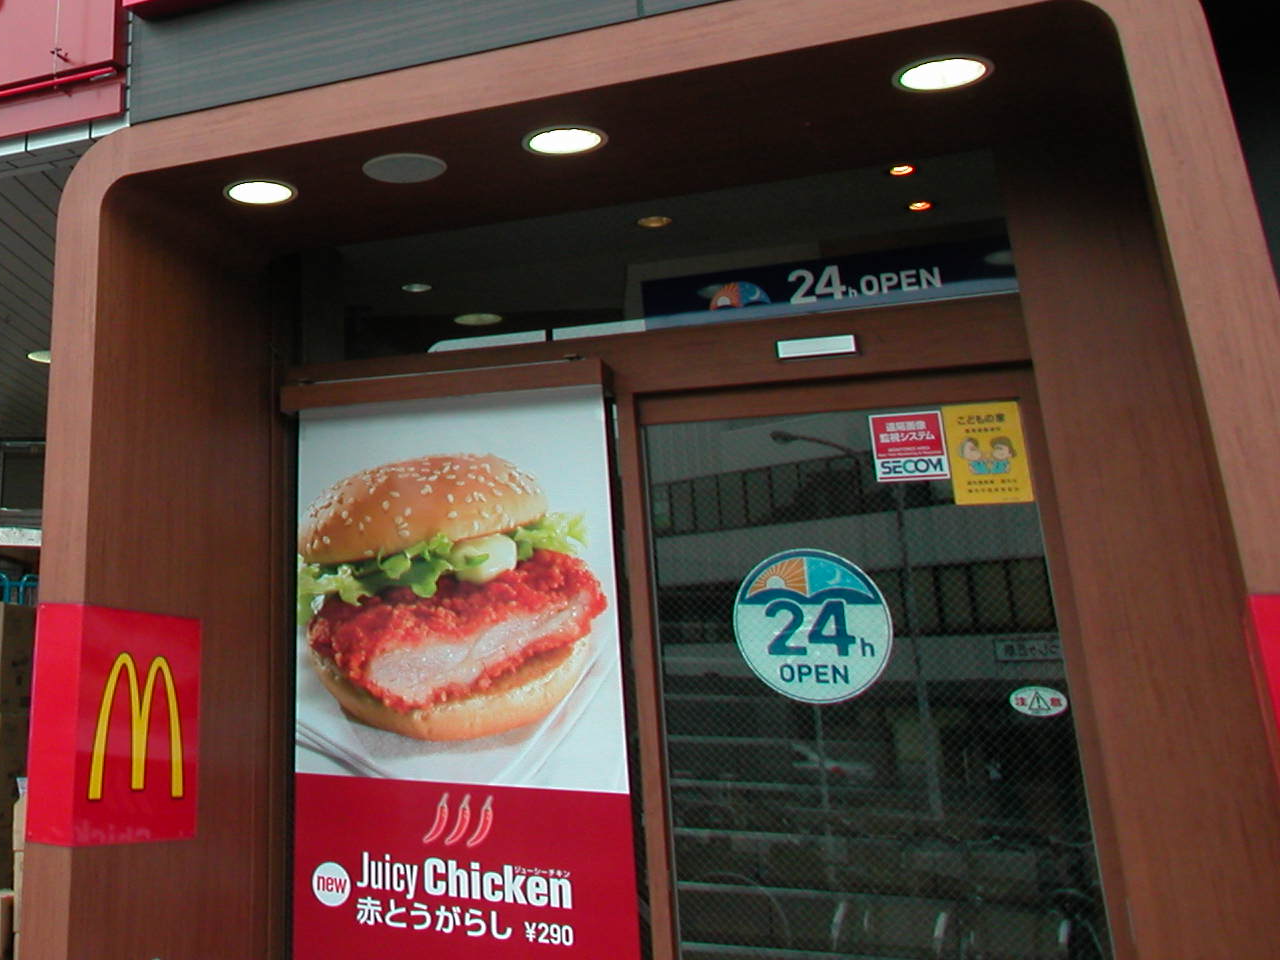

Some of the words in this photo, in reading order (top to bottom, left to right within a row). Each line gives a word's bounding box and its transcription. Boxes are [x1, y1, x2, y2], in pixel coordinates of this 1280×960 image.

[859, 266, 943, 297] OPEN
[880, 458, 944, 475] SECOM
[764, 599, 876, 658] 24h
[779, 663, 851, 685] OPEN
[316, 873, 348, 894] new
[356, 851, 419, 900] Juicy
[423, 856, 574, 910] Chicken
[356, 896, 514, 941] 赤とうがらし
[524, 920, 575, 947] ¥290
